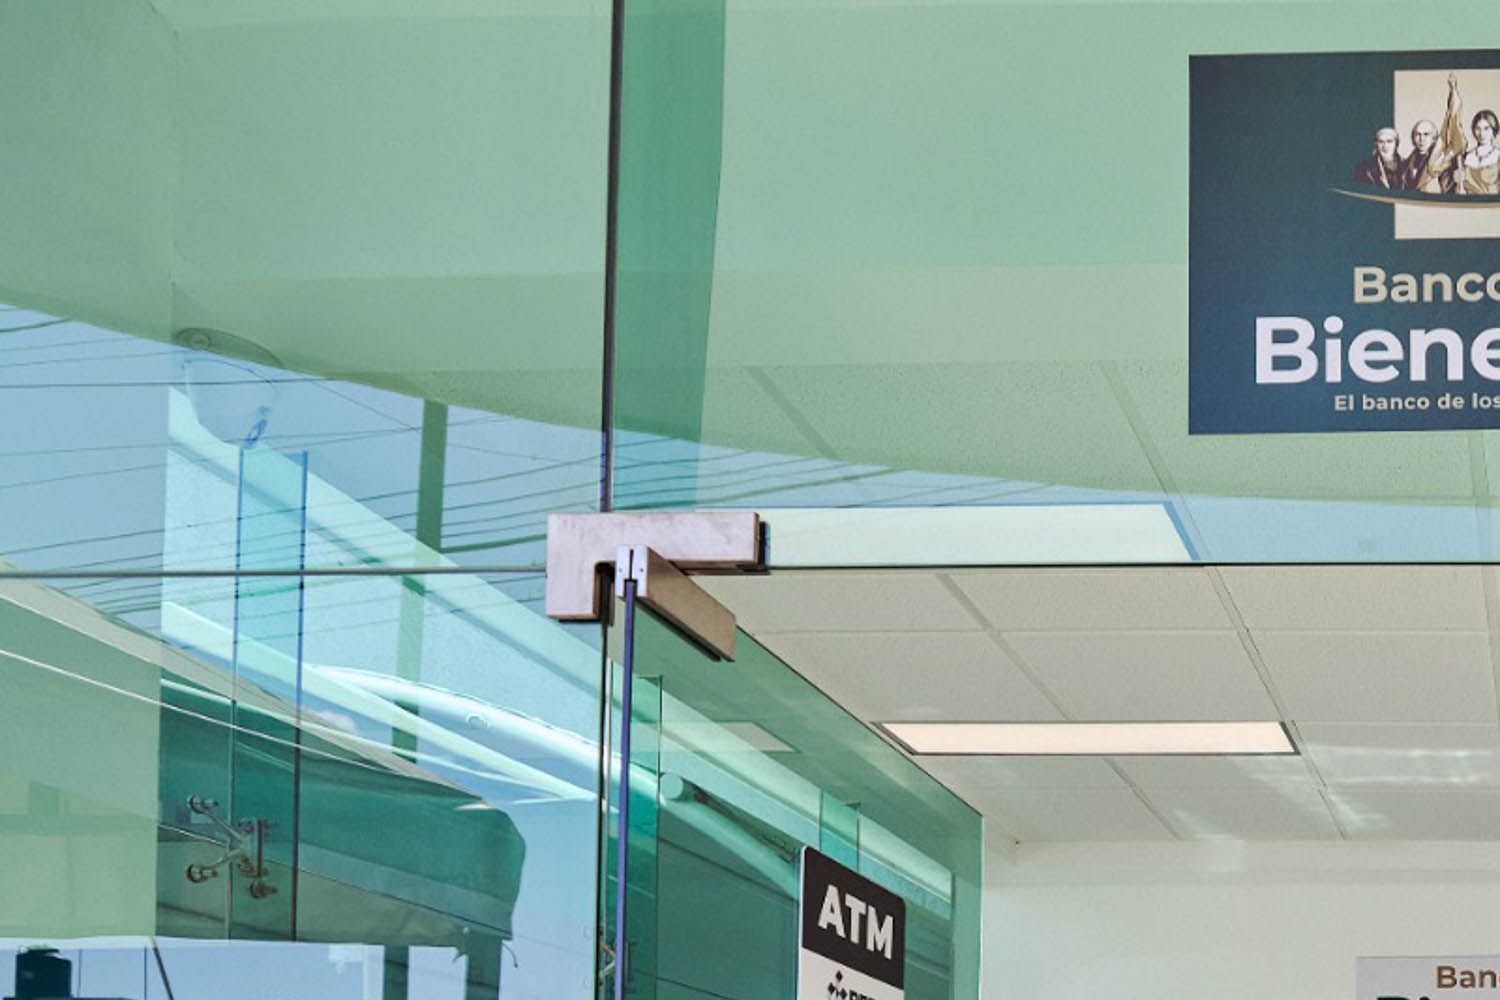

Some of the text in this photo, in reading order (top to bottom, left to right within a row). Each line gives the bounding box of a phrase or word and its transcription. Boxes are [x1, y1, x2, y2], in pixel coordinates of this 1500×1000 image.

[1334, 394, 1355, 411] El
[1362, 393, 1430, 411] banco
[1437, 392, 1465, 410] de
[818, 884, 894, 960] ATM
